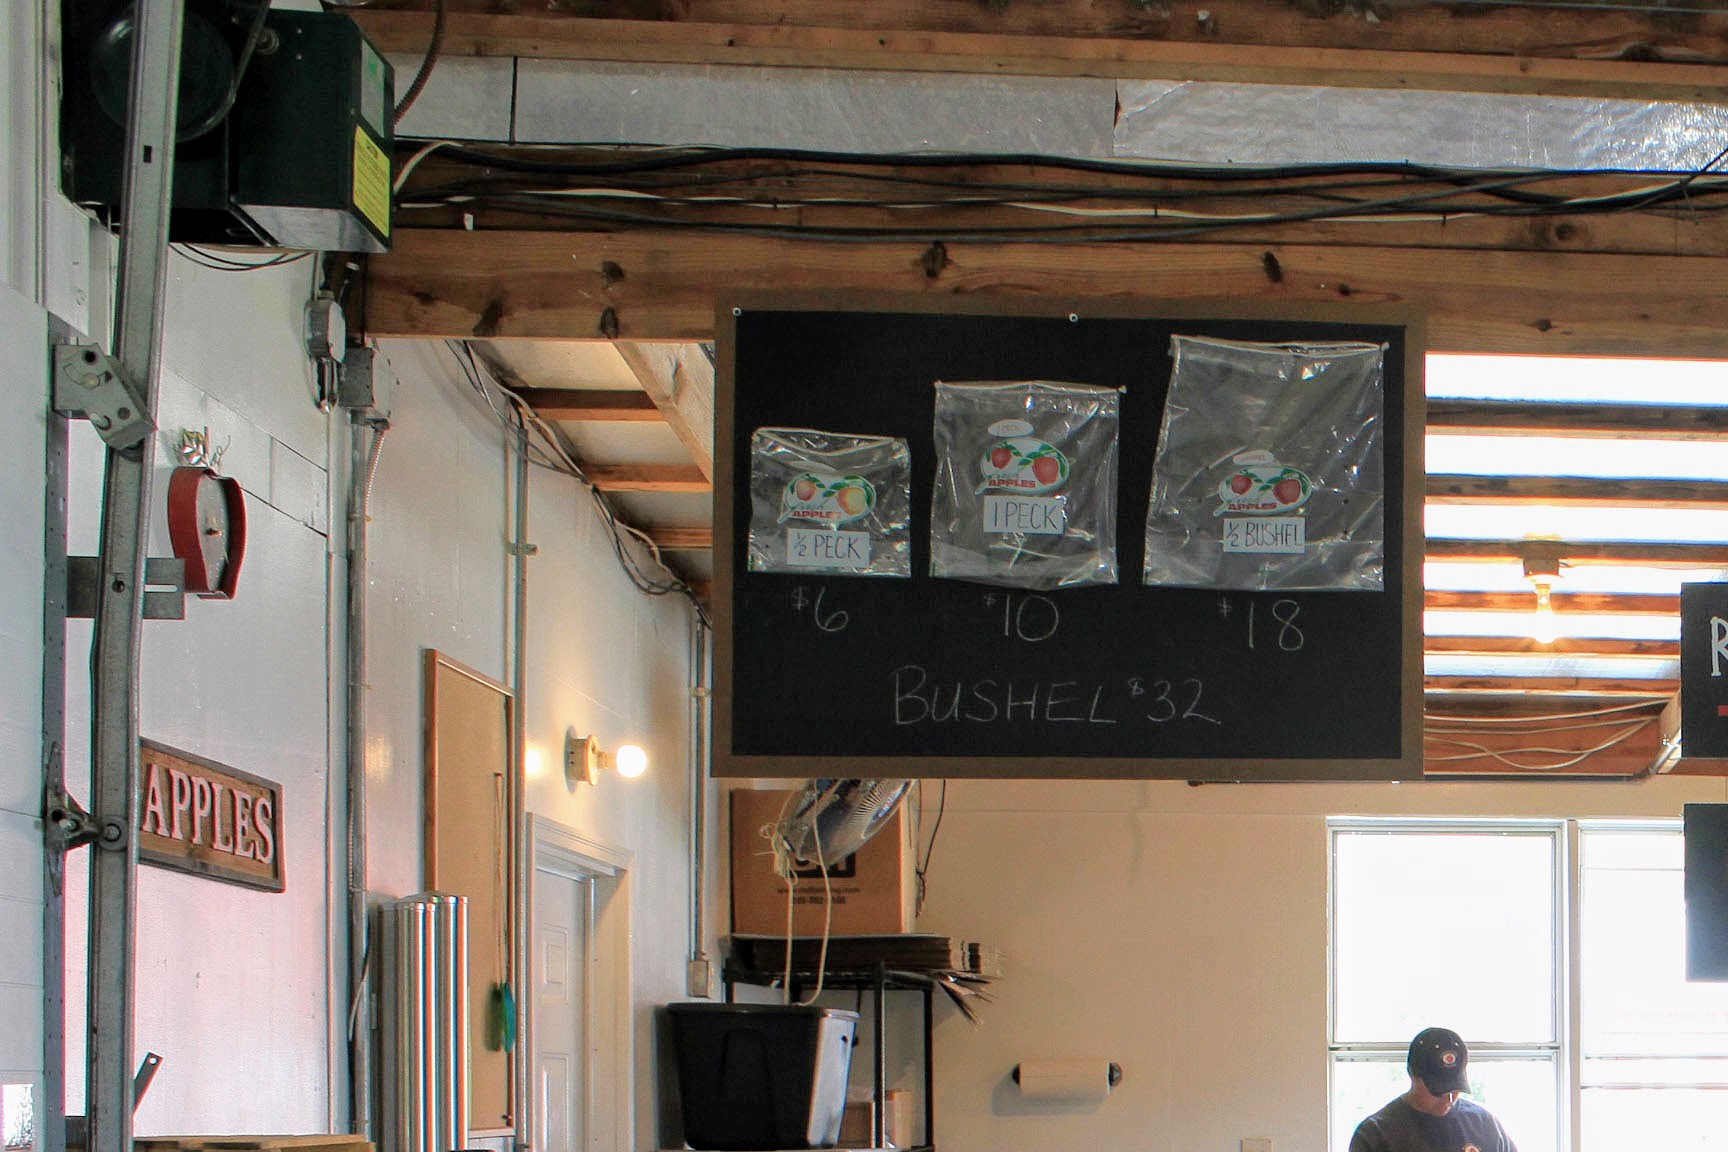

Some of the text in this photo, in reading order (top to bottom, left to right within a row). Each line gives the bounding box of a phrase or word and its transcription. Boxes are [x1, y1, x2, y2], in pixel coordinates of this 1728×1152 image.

[988, 478, 1036, 489] APPLES
[1005, 501, 1058, 530] PECK
[1227, 502, 1278, 511] APPLES
[814, 534, 862, 560] PECK
[1244, 521, 1304, 547] BUSHEL
[894, 664, 1222, 726] BUSHEL $32
[141, 763, 273, 865] APPLES
